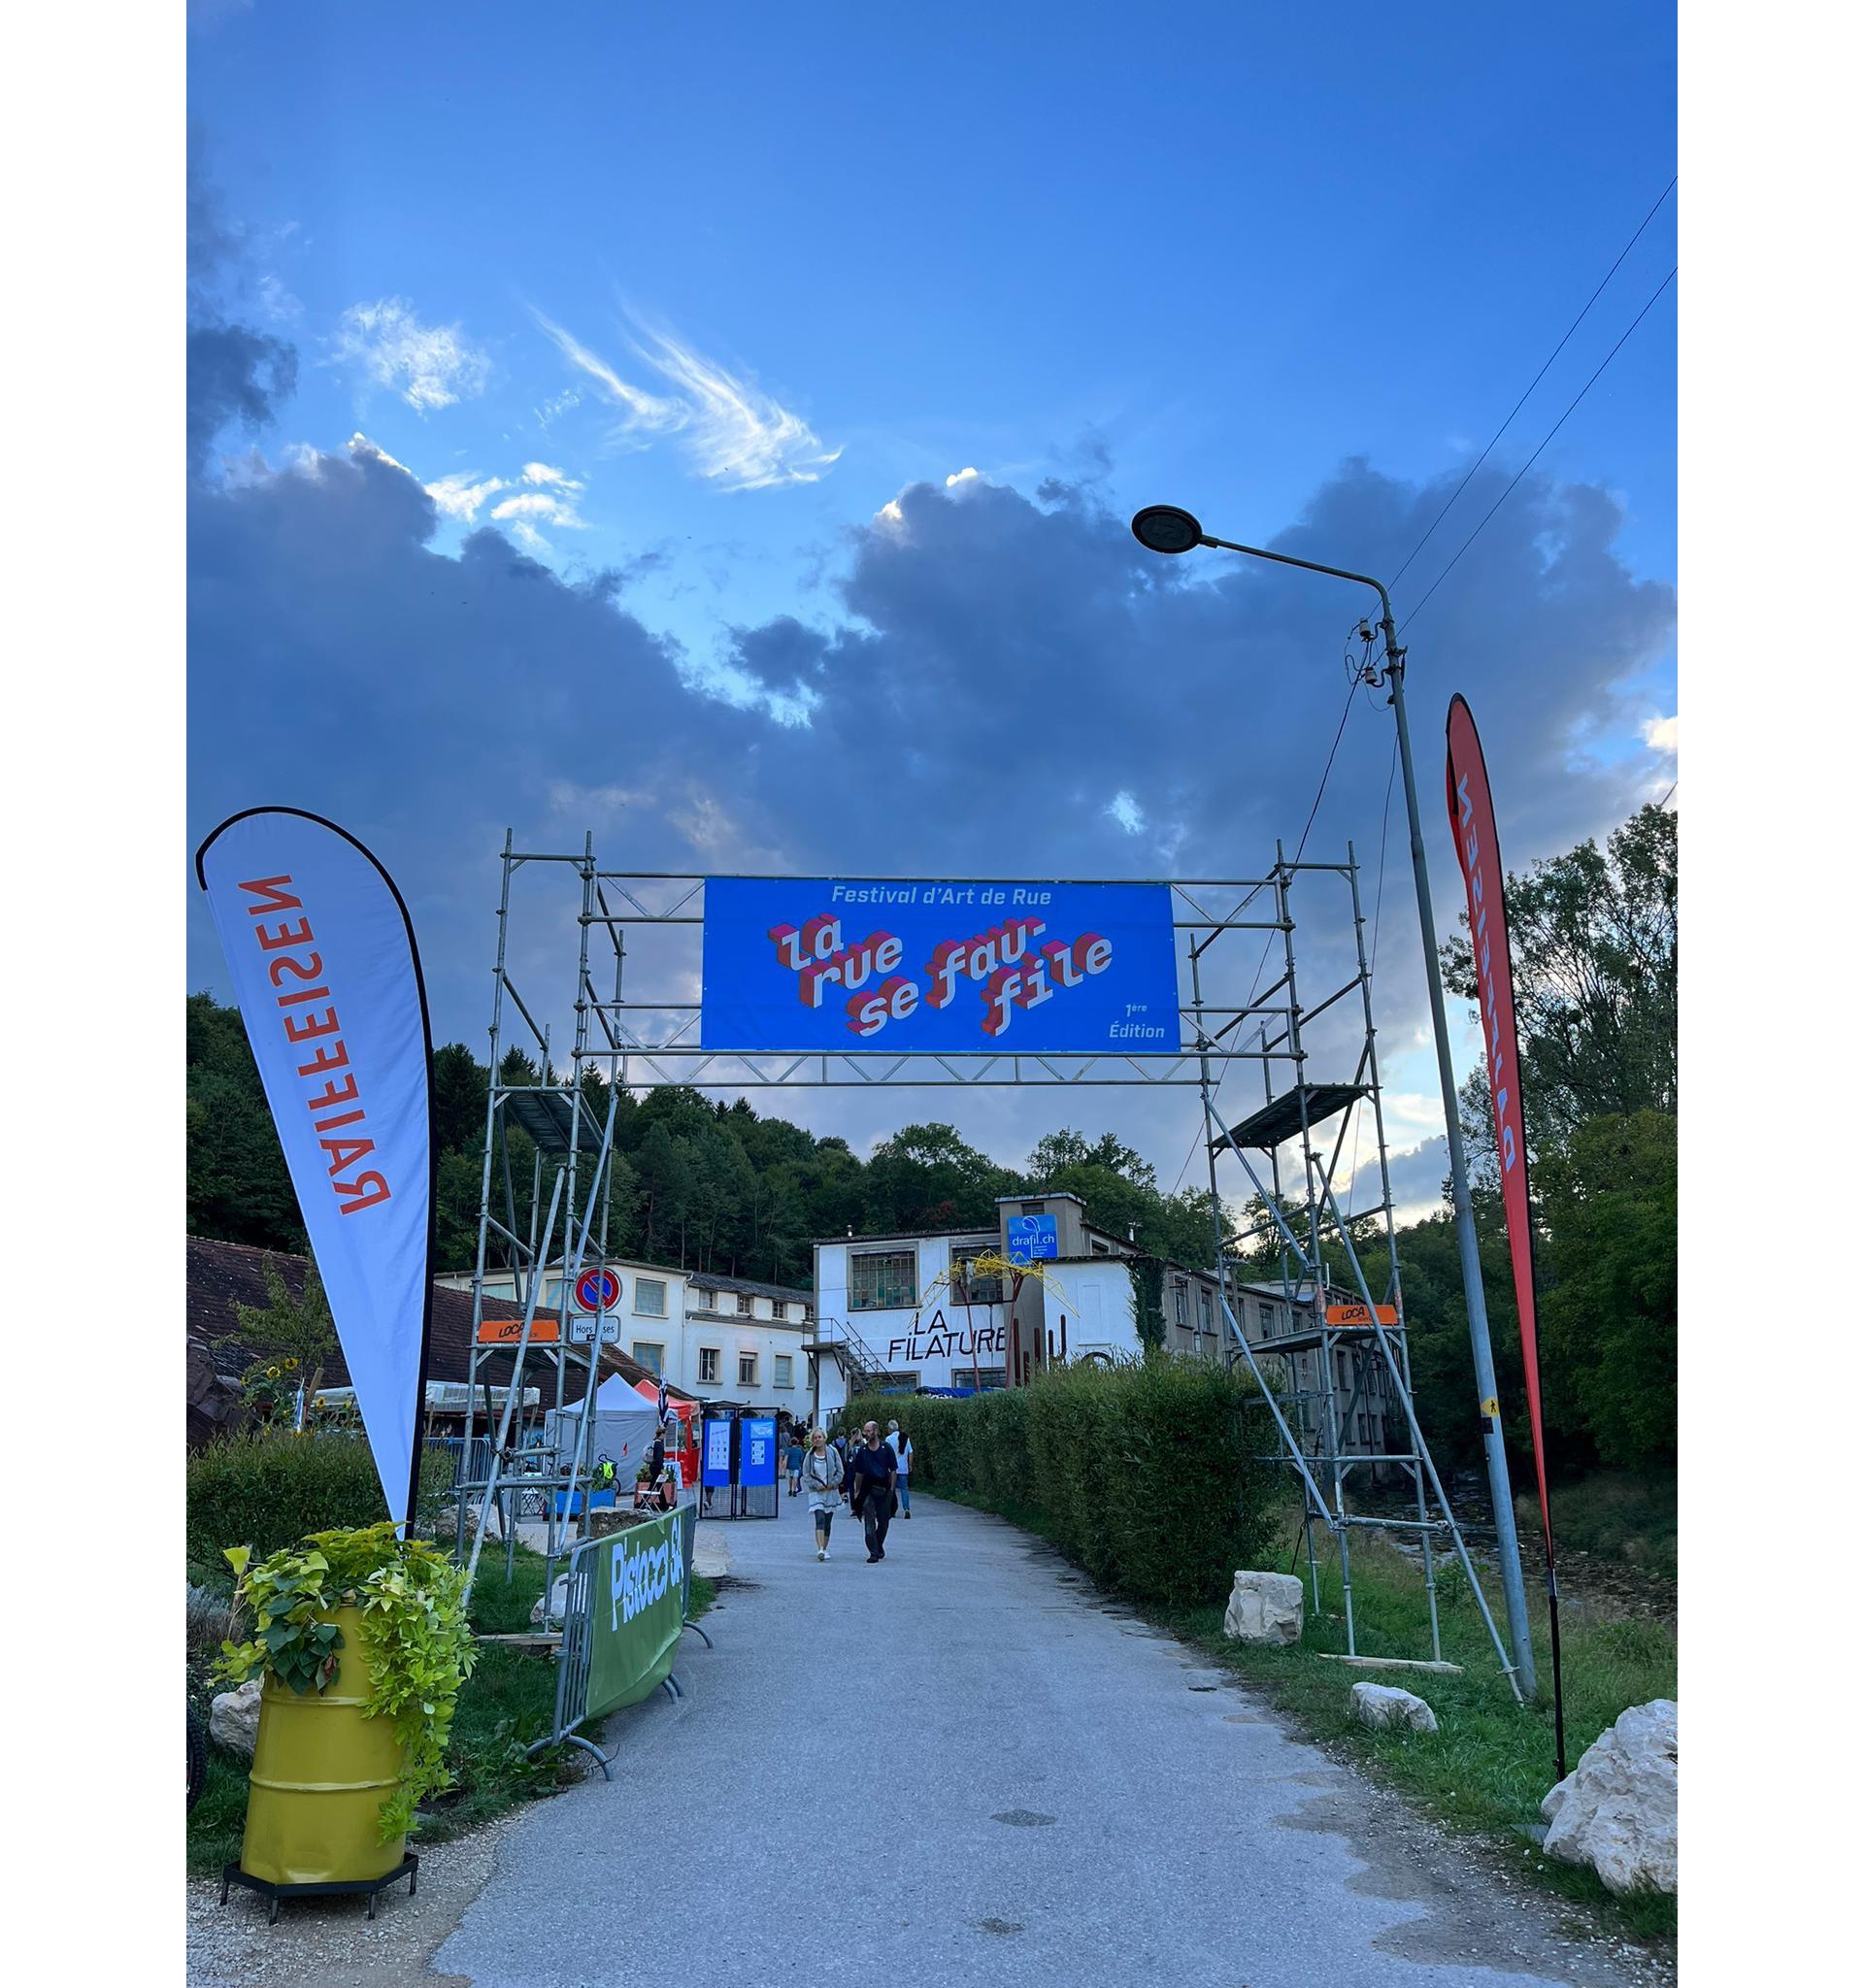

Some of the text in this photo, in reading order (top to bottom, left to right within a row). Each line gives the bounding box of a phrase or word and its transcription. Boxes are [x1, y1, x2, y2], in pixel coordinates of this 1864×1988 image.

[832, 885, 916, 904] Festival
[981, 888, 1005, 905] de
[1013, 888, 1051, 905] Rue
[780, 918, 845, 971] la
[812, 936, 903, 1009] rue
[992, 937, 1113, 1037] file
[857, 980, 919, 1037] se
[1109, 1020, 1165, 1039] Édition
[1012, 1233, 1055, 1249] drafil.ch
[576, 1325, 593, 1334] Hors
[915, 1309, 948, 1336] LA
[670, 1514, 683, 1587] SA
